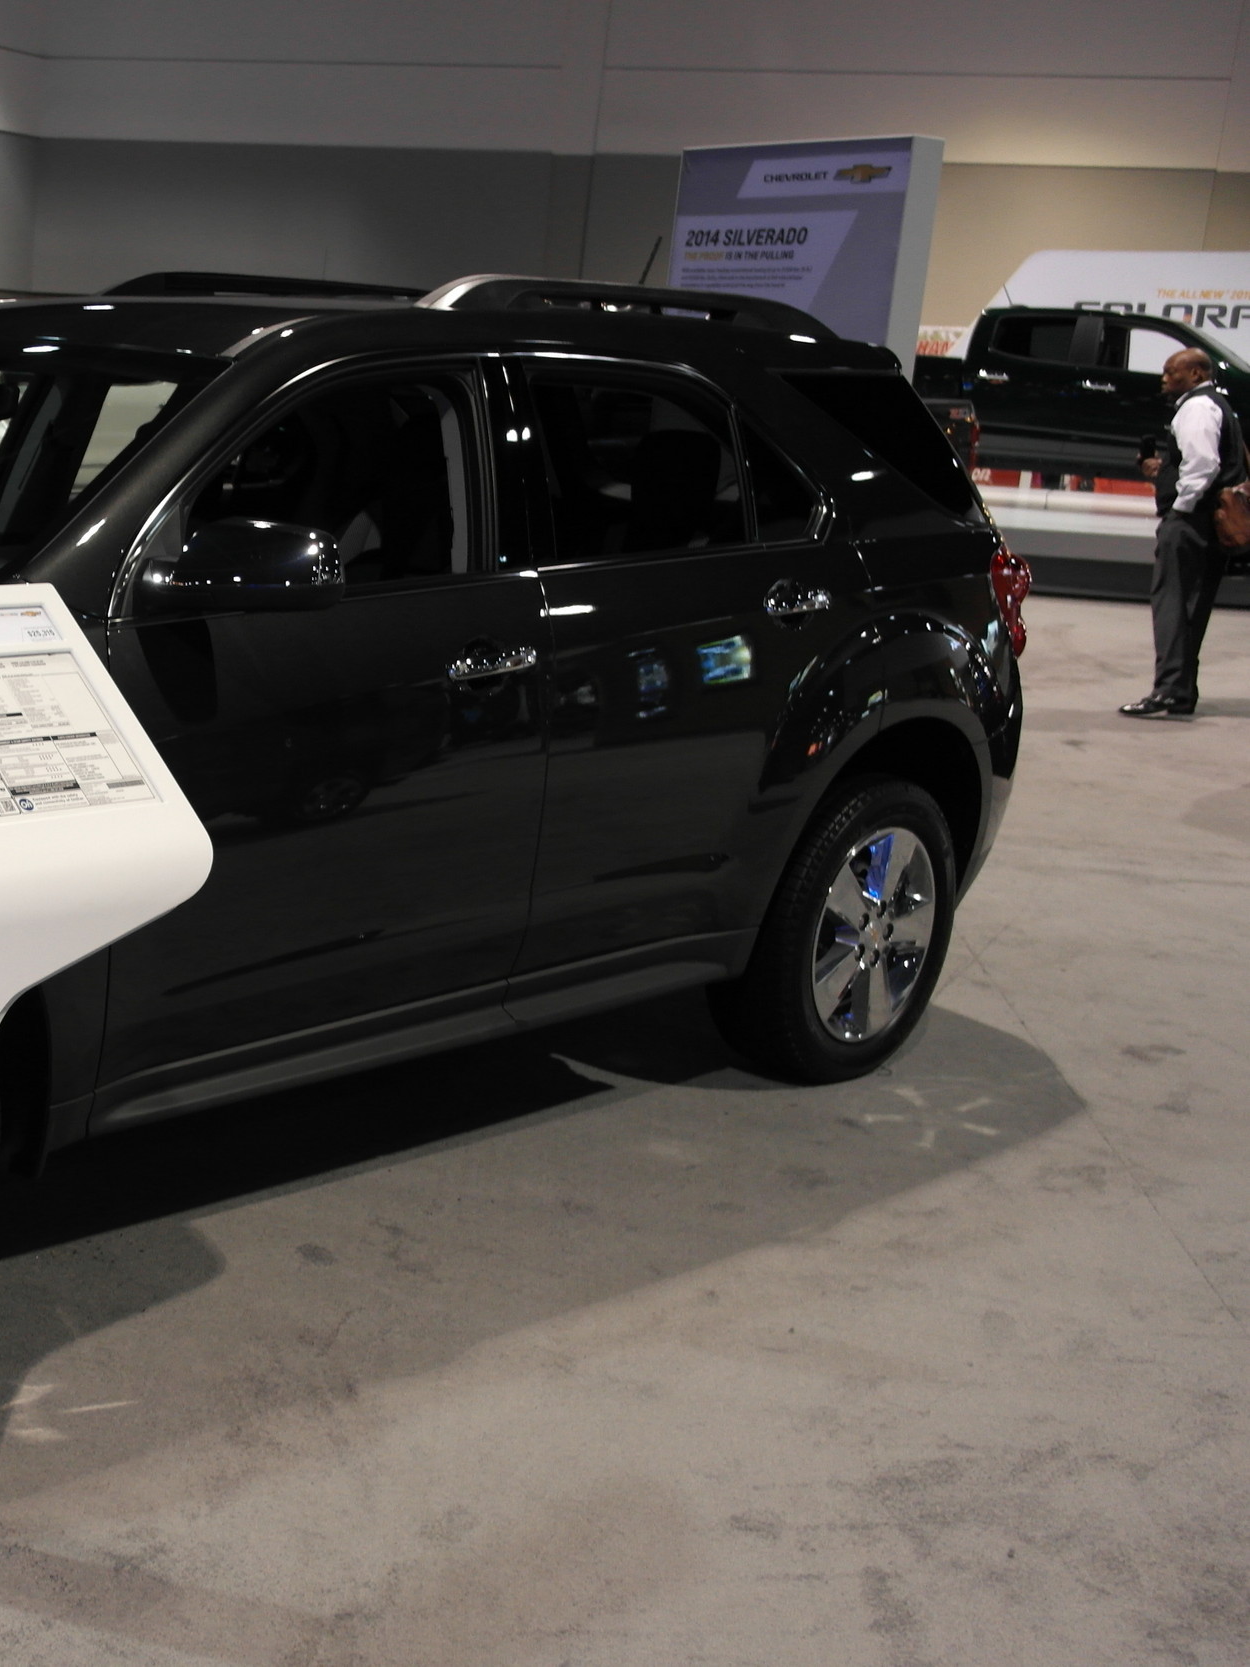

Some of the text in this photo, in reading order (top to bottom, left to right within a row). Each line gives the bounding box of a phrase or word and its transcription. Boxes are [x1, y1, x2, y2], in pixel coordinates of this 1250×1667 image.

[763, 171, 828, 183] CHEVROLET
[685, 227, 808, 247] 2014 SILVERADO
[725, 251, 733, 260] IS
[734, 251, 744, 260] IN
[744, 251, 759, 260] THE
[760, 250, 795, 260] PULLING
[1158, 288, 1176, 299] THE
